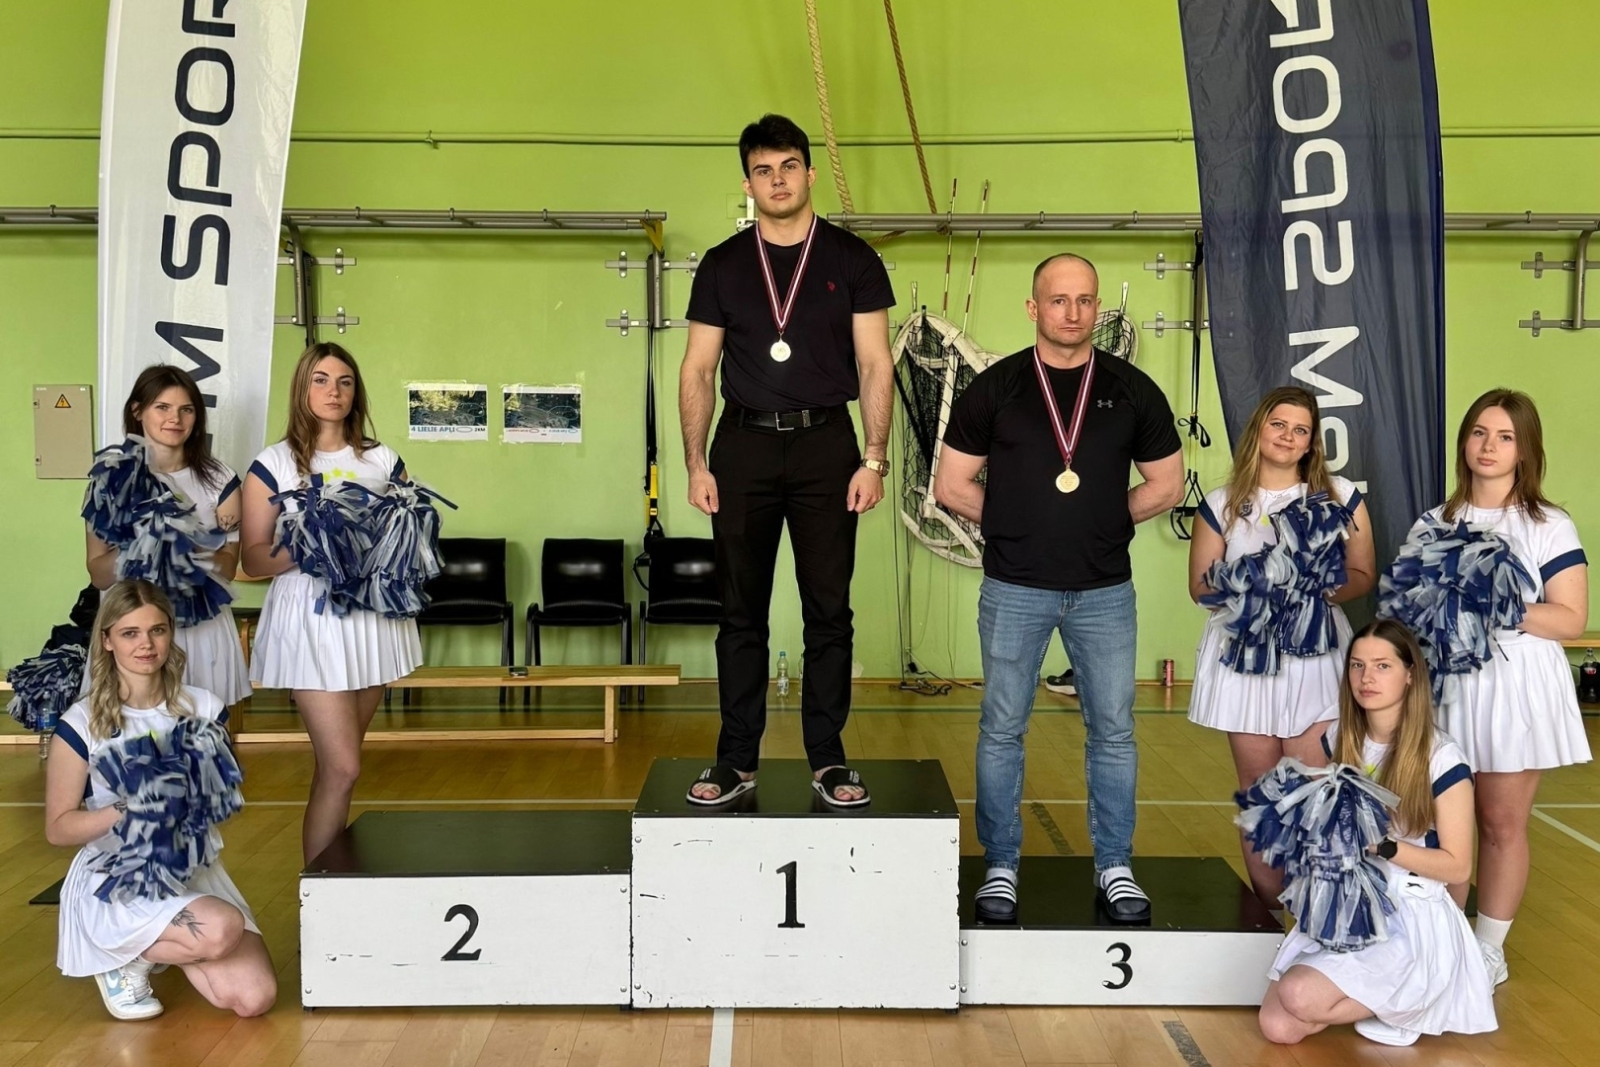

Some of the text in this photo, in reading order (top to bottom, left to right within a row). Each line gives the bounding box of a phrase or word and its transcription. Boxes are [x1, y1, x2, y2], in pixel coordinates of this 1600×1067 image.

[775, 861, 806, 929] 1
[441, 903, 481, 962] 2
[1101, 942, 1134, 990] 3
